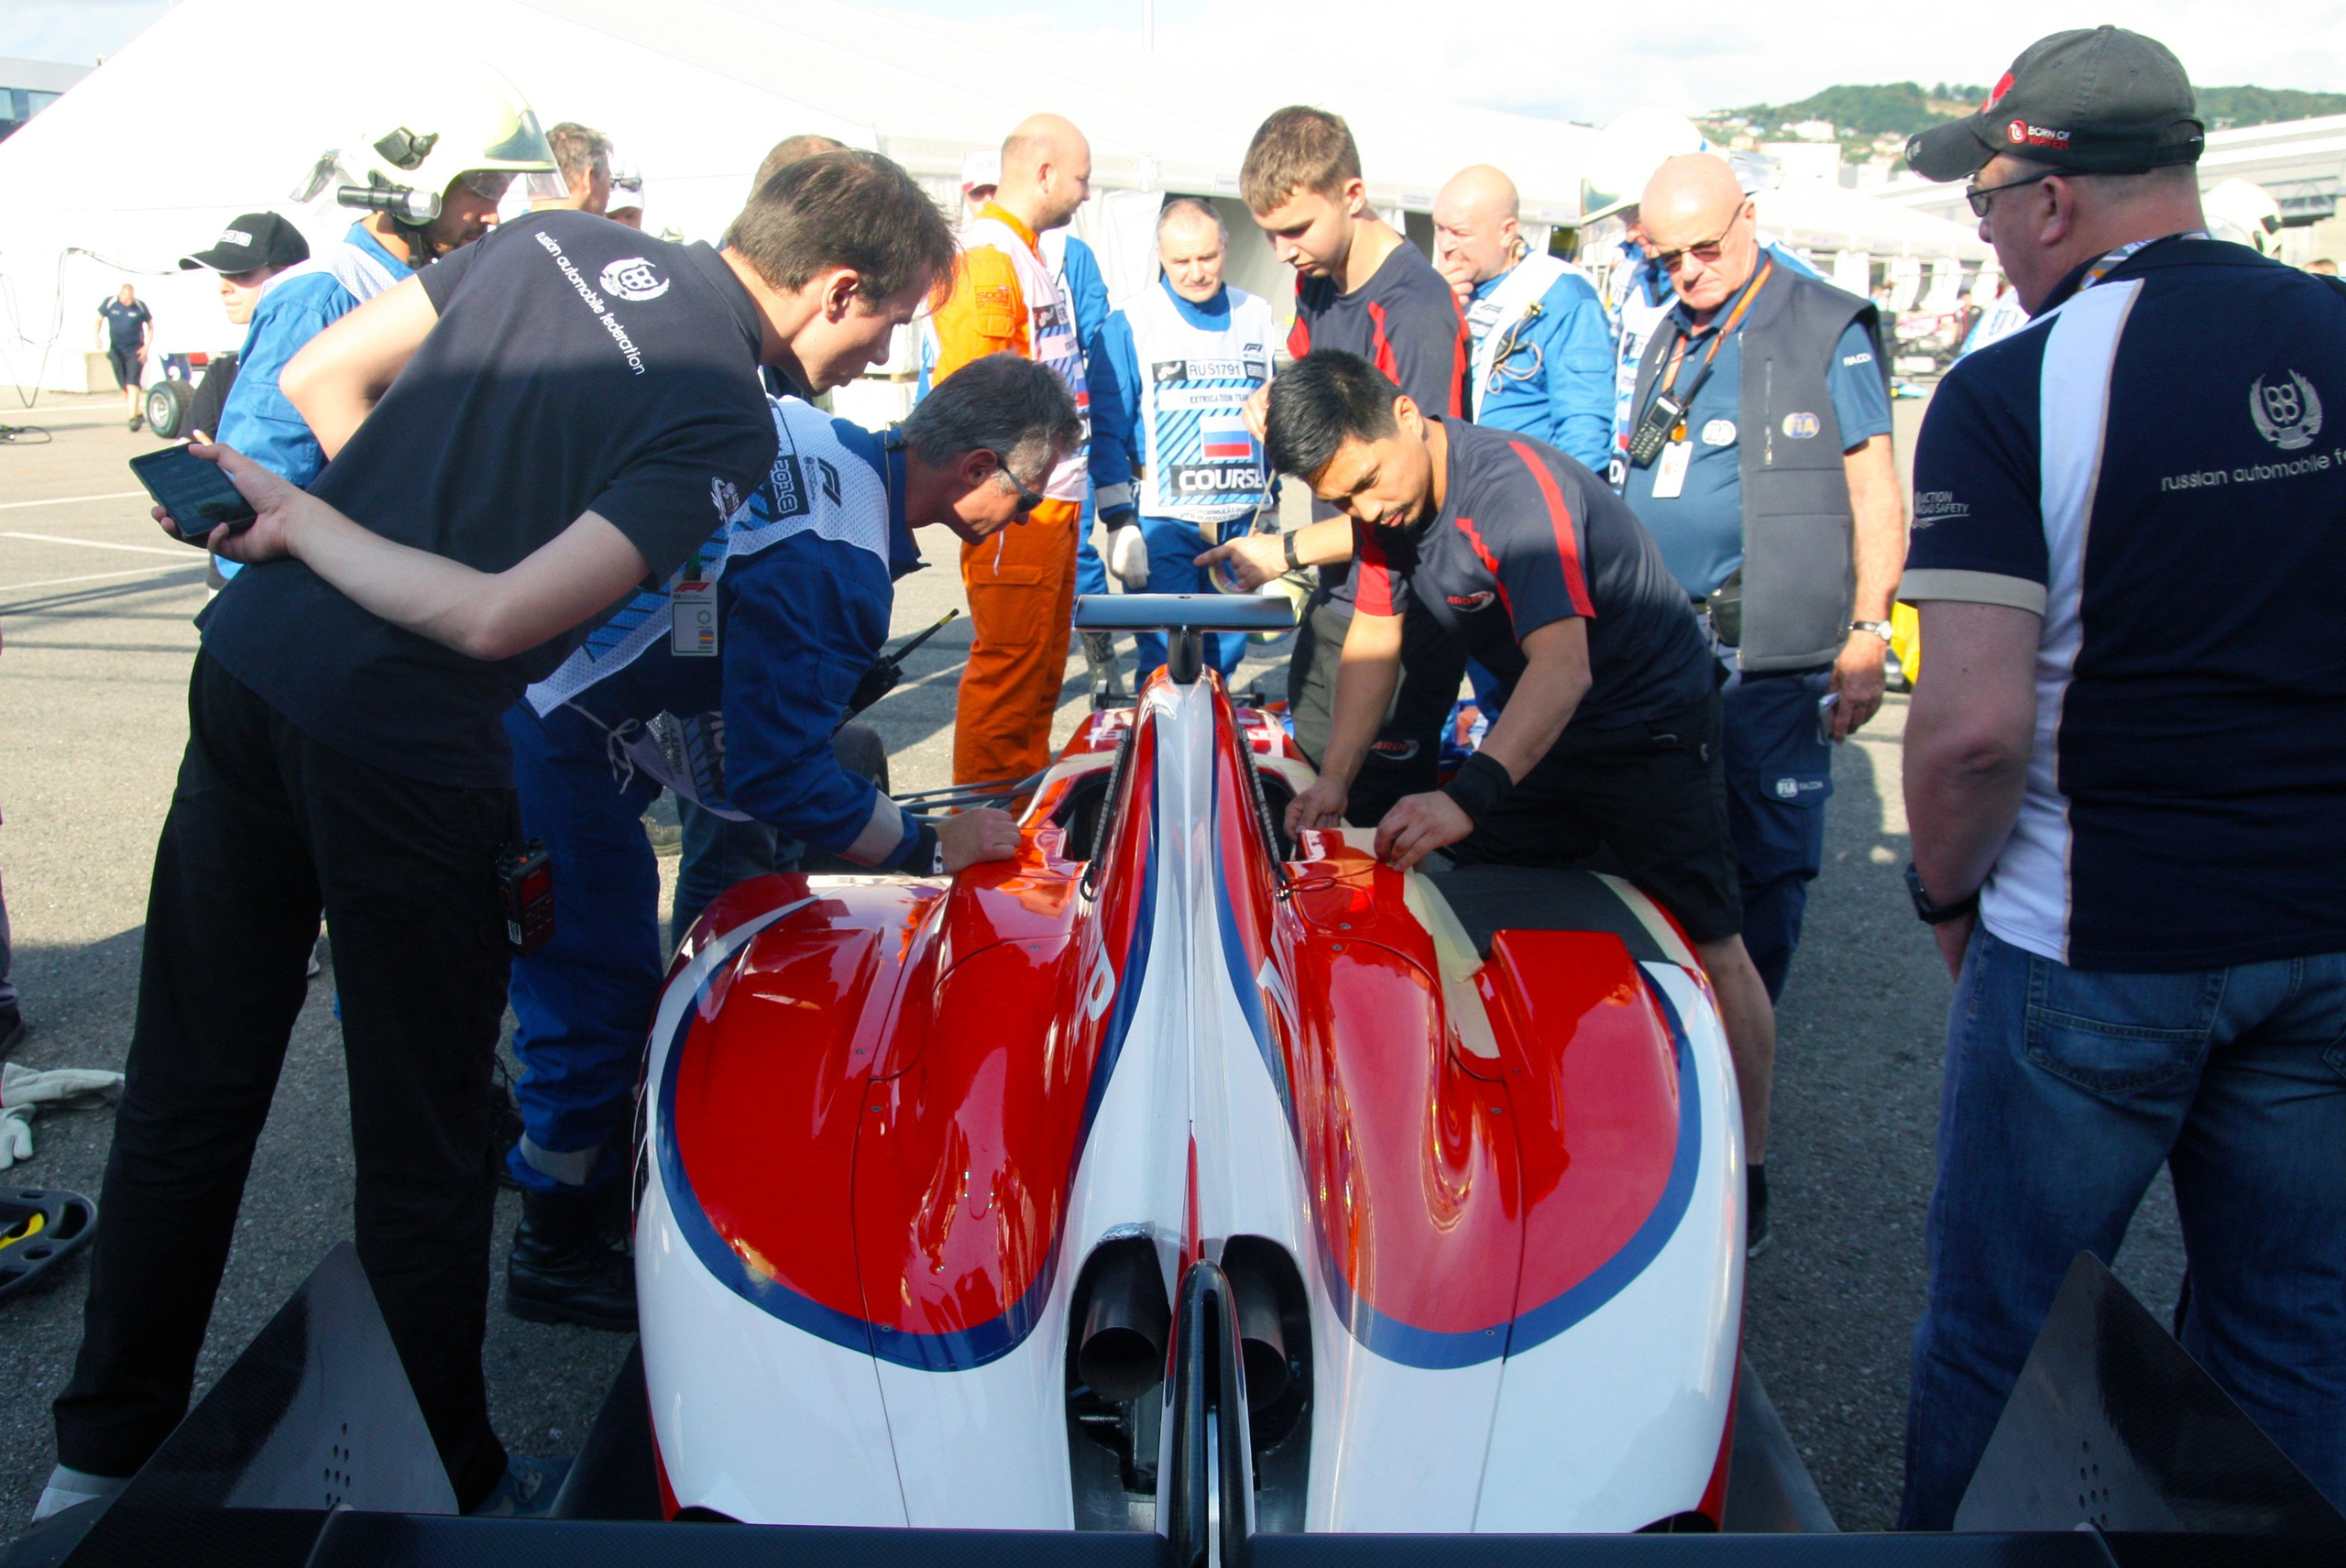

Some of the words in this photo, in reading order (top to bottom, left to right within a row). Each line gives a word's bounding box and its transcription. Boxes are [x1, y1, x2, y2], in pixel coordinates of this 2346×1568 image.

[2028, 126, 2055, 137] BORN
[2056, 131, 2071, 141] OF
[2029, 137, 2070, 149] WATER
[535, 231, 562, 257] russian
[556, 256, 605, 314] automobile
[600, 313, 645, 375] federation
[1189, 364, 1241, 377] RUS1791
[1189, 394, 1233, 403] EXTRICATION
[2161, 470, 2228, 491] russian
[2232, 455, 2330, 483] automobile
[771, 459, 797, 514] 2018
[1935, 502, 1969, 513] SAFETY
[1446, 591, 1492, 605] ARDEN
